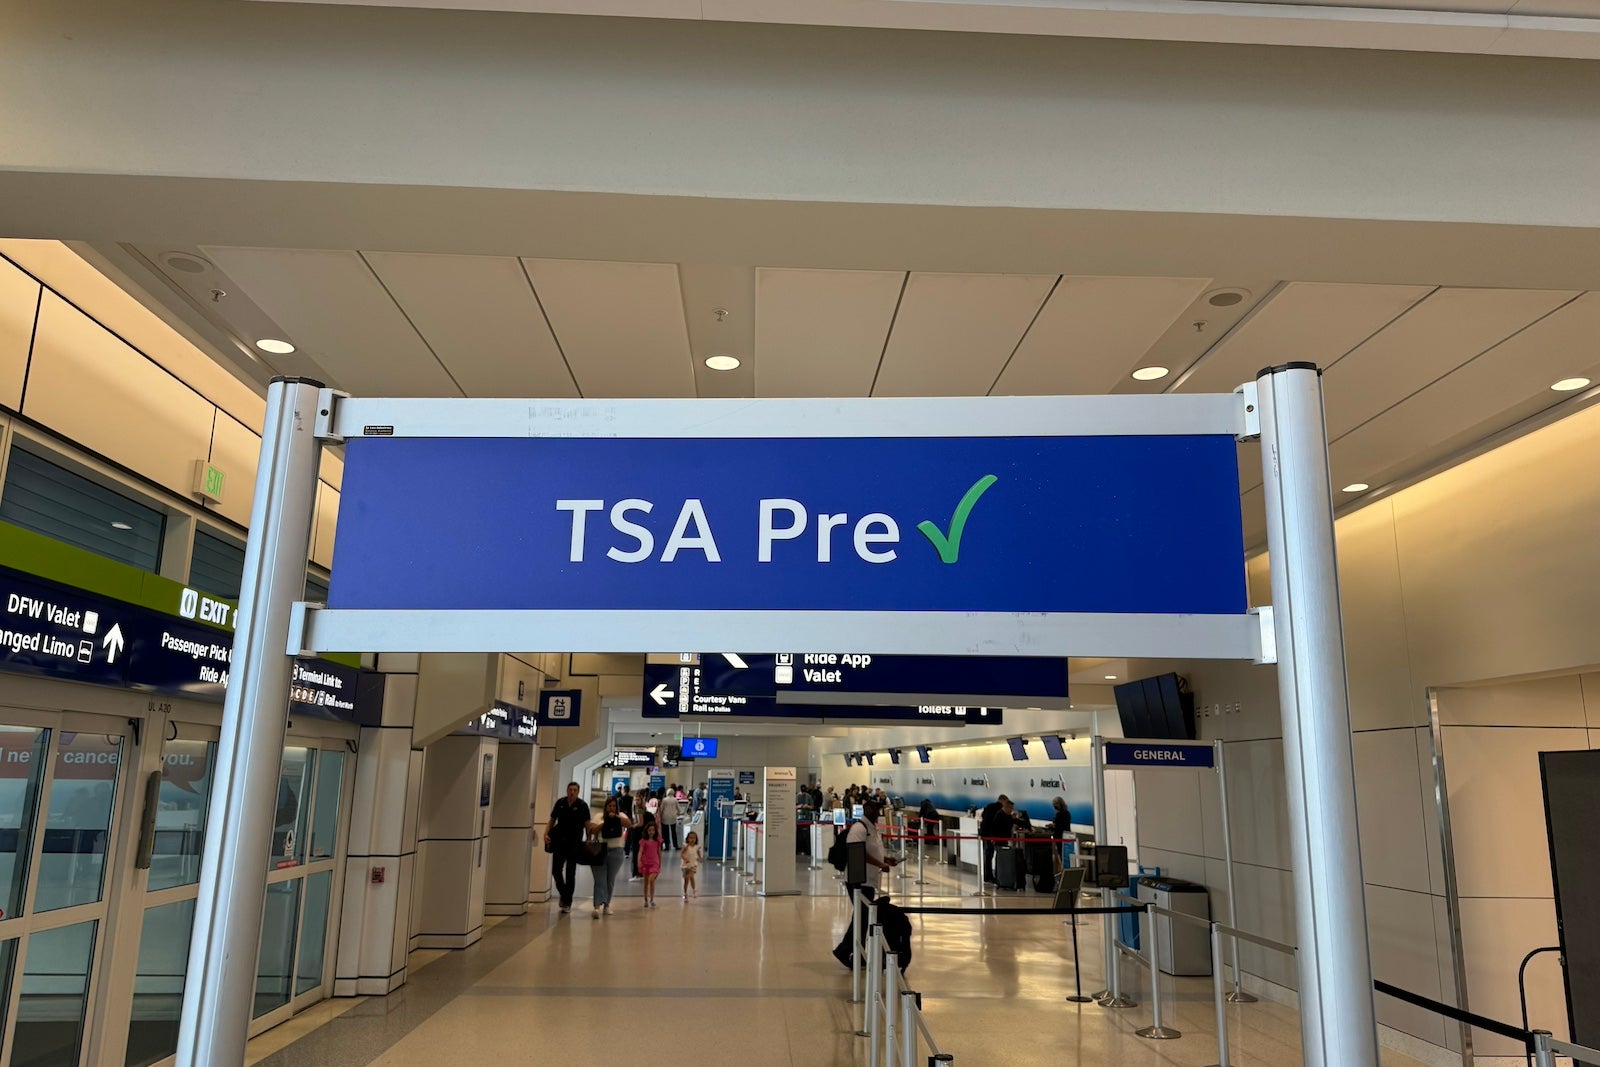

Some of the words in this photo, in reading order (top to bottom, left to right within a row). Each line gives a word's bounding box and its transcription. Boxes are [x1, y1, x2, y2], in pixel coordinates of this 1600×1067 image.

[206, 466, 224, 497] EXIT
[556, 498, 721, 563] TSA
[758, 498, 900, 563] Pre
[7, 593, 44, 619] DFW
[46, 603, 81, 629] Valet
[200, 597, 230, 625] EXIT
[42, 634, 75, 658] Limo
[161, 632, 209, 659] Passenger
[209, 644, 228, 662] Pick
[804, 653, 837, 664] Ride
[841, 653, 871, 668] App
[199, 666, 219, 683] Ride
[299, 667, 323, 685] Terminal
[323, 674, 335, 688] Link
[803, 668, 842, 682] Valet
[325, 693, 336, 706] Rail
[693, 695, 727, 705] Courtesy
[728, 696, 747, 704] Vans
[693, 704, 708, 712] Rail
[714, 705, 731, 713] Dallas
[63, 749, 118, 764] cance
[1133, 749, 1186, 761] GENERAL
[1040, 778, 1060, 788] American
